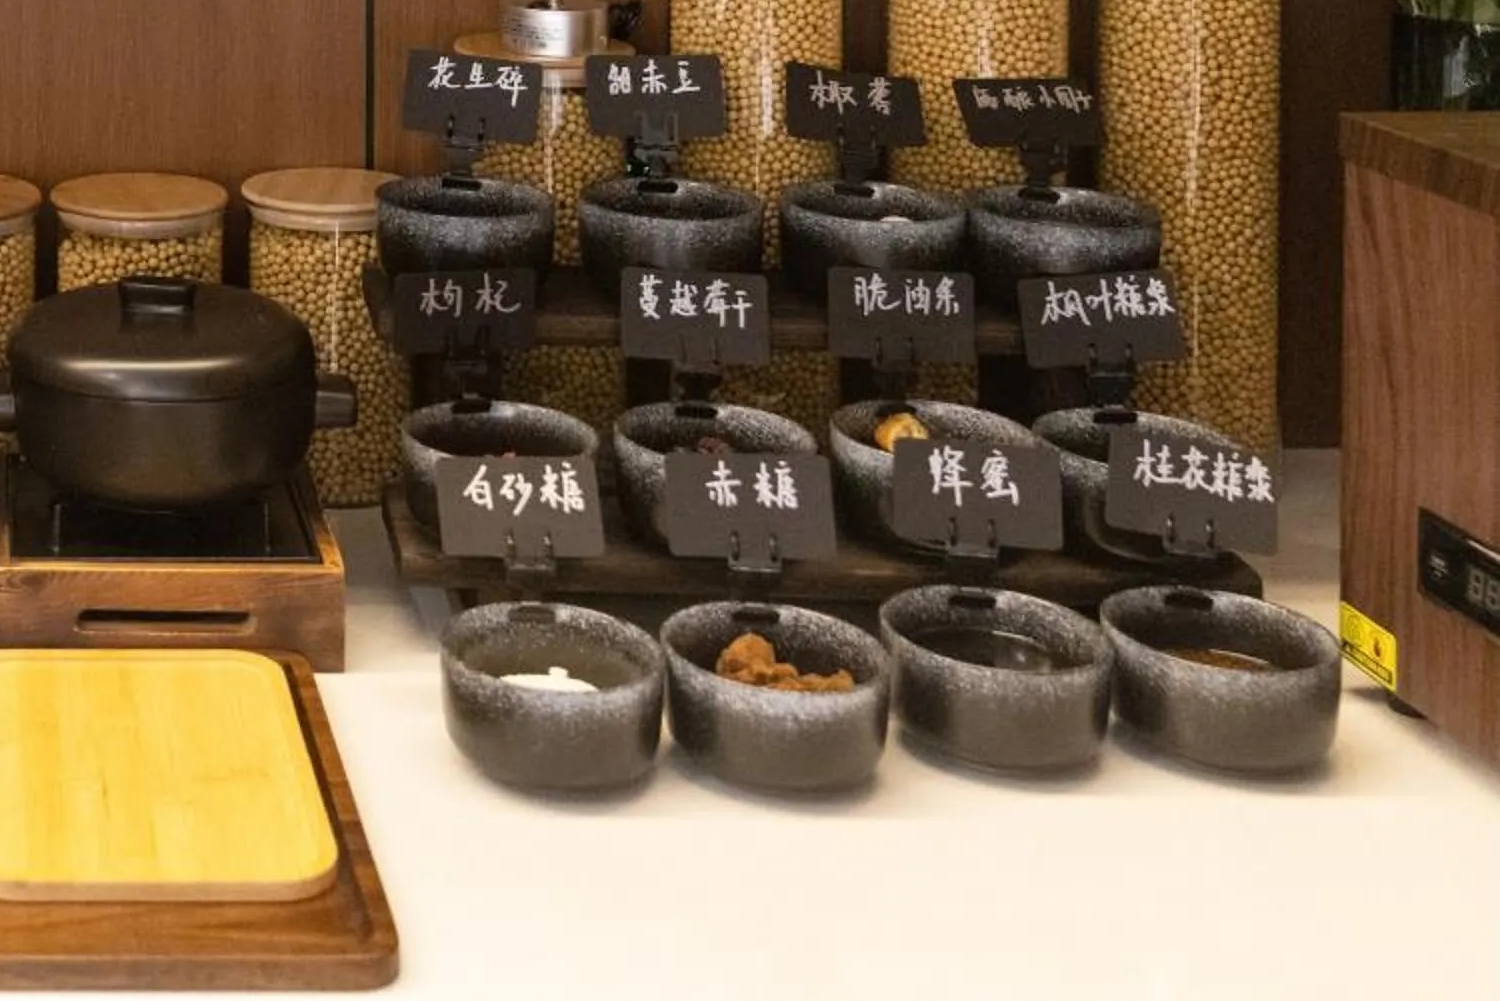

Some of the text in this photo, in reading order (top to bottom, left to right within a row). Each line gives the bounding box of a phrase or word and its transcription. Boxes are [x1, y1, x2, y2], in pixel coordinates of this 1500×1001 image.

[419, 272, 521, 318] 枸杞
[854, 272, 960, 316] 脆油条
[463, 461, 585, 516] 白砂糖
[928, 445, 1019, 507] 蜂蜜
